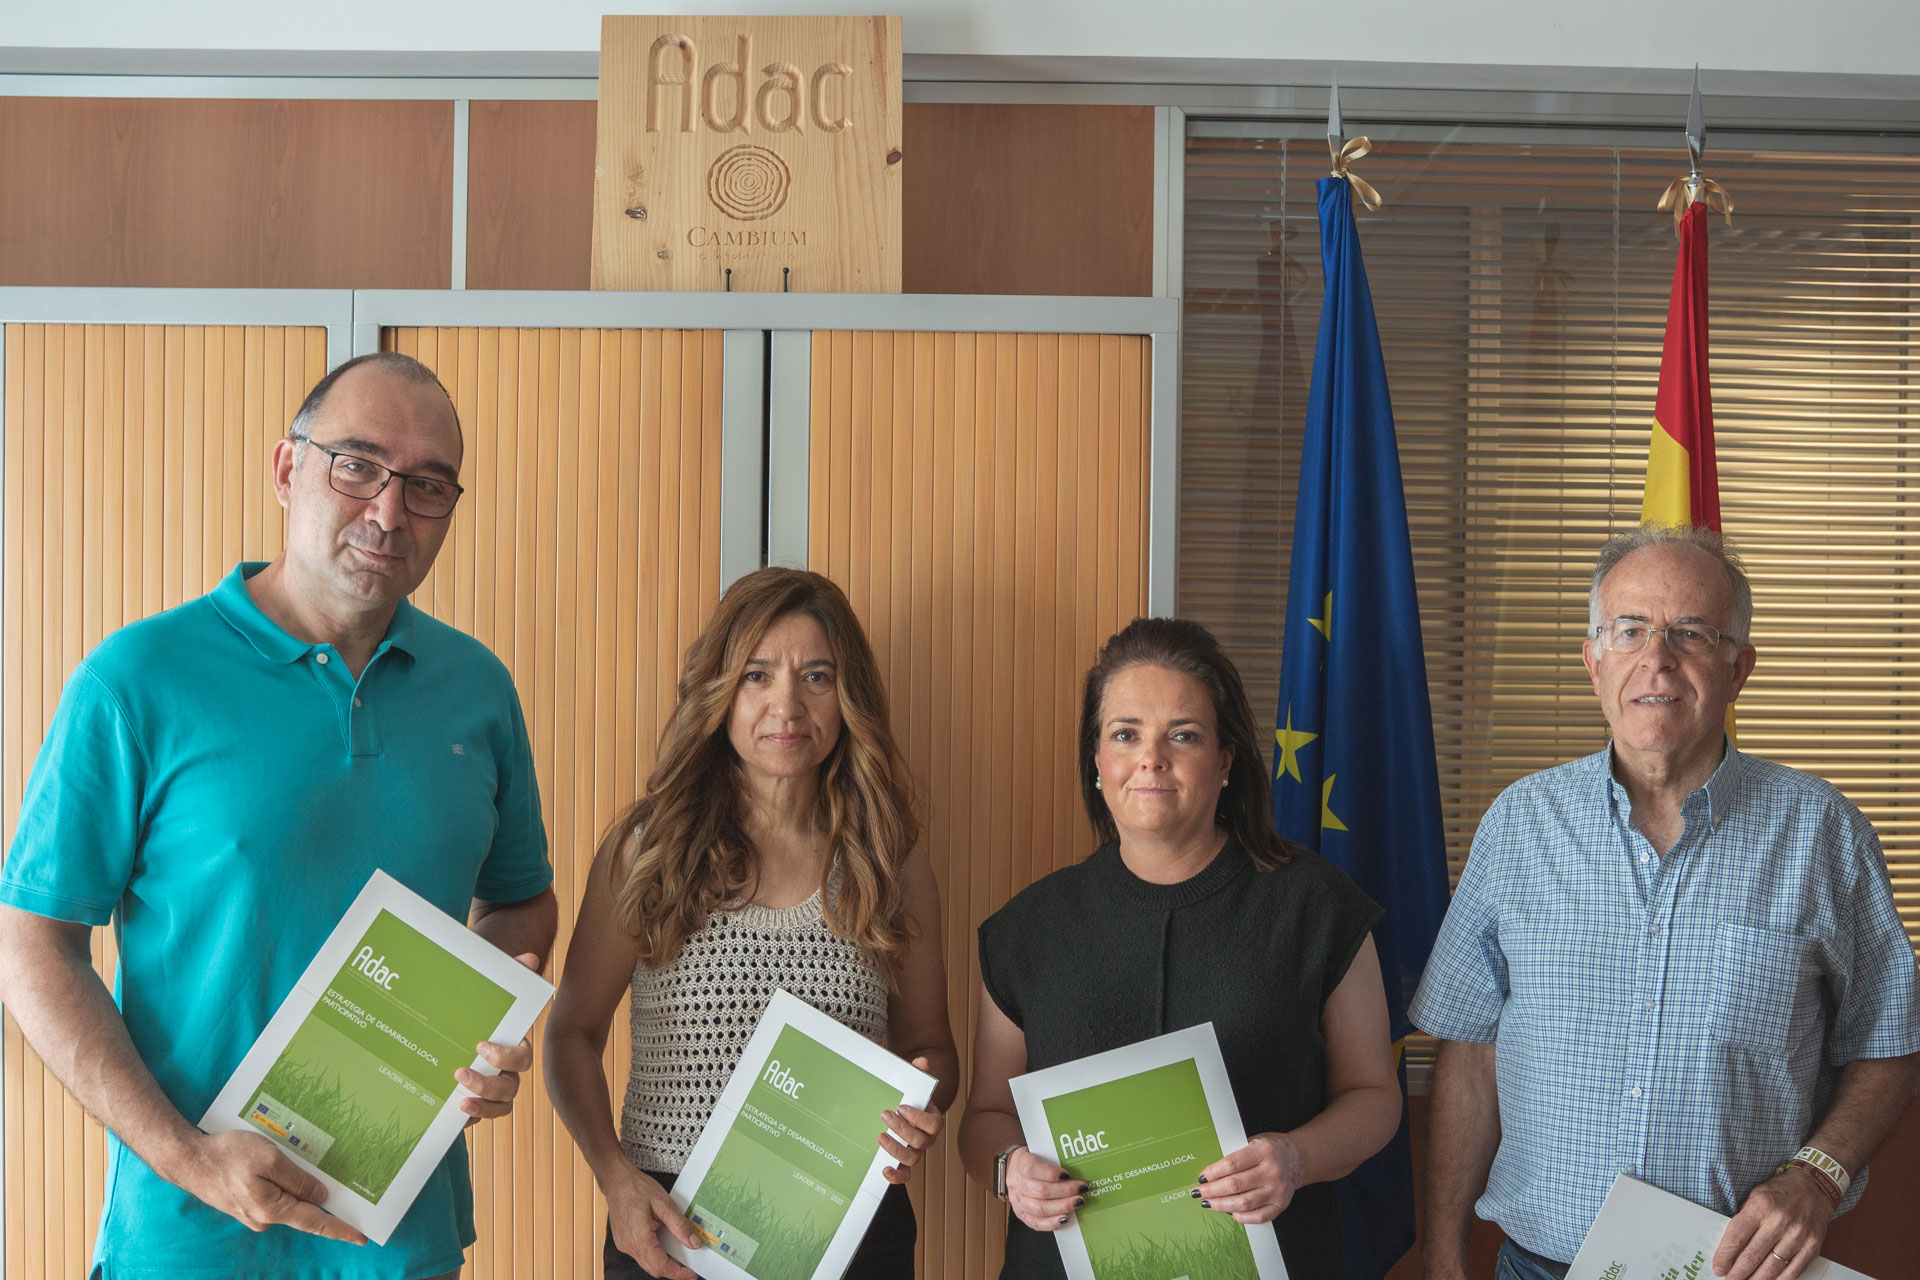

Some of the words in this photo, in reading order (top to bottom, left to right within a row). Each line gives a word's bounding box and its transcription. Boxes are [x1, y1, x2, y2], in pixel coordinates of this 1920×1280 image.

[646, 33, 854, 136] Adac
[687, 226, 808, 248] CAMBIUM
[351, 945, 400, 991] Adac
[321, 995, 368, 1030] PARTICIPATIVO
[327, 988, 365, 1017] ESTRATEGIA
[366, 1013, 377, 1024] DE
[375, 1020, 418, 1051] DESARROLLO
[416, 1047, 439, 1067] LOCAL
[378, 1065, 404, 1085] LEADER
[762, 1059, 805, 1099] Adac
[740, 1110, 781, 1138] PARTICIPATIVO
[744, 1103, 778, 1128] ESTRATEGIA
[778, 1123, 788, 1133] DE
[787, 1128, 825, 1155] DESARROLLO
[824, 1151, 845, 1168] LOCAL
[1059, 1129, 1109, 1160] Adac
[792, 1170, 815, 1189] LEADER
[1088, 1177, 1112, 1189] ATEGIA
[1113, 1173, 1124, 1183] DE
[1125, 1160, 1171, 1179] DESARROLLO
[1171, 1153, 1196, 1166] LOCAL
[1160, 1190, 1187, 1204] LEADER
